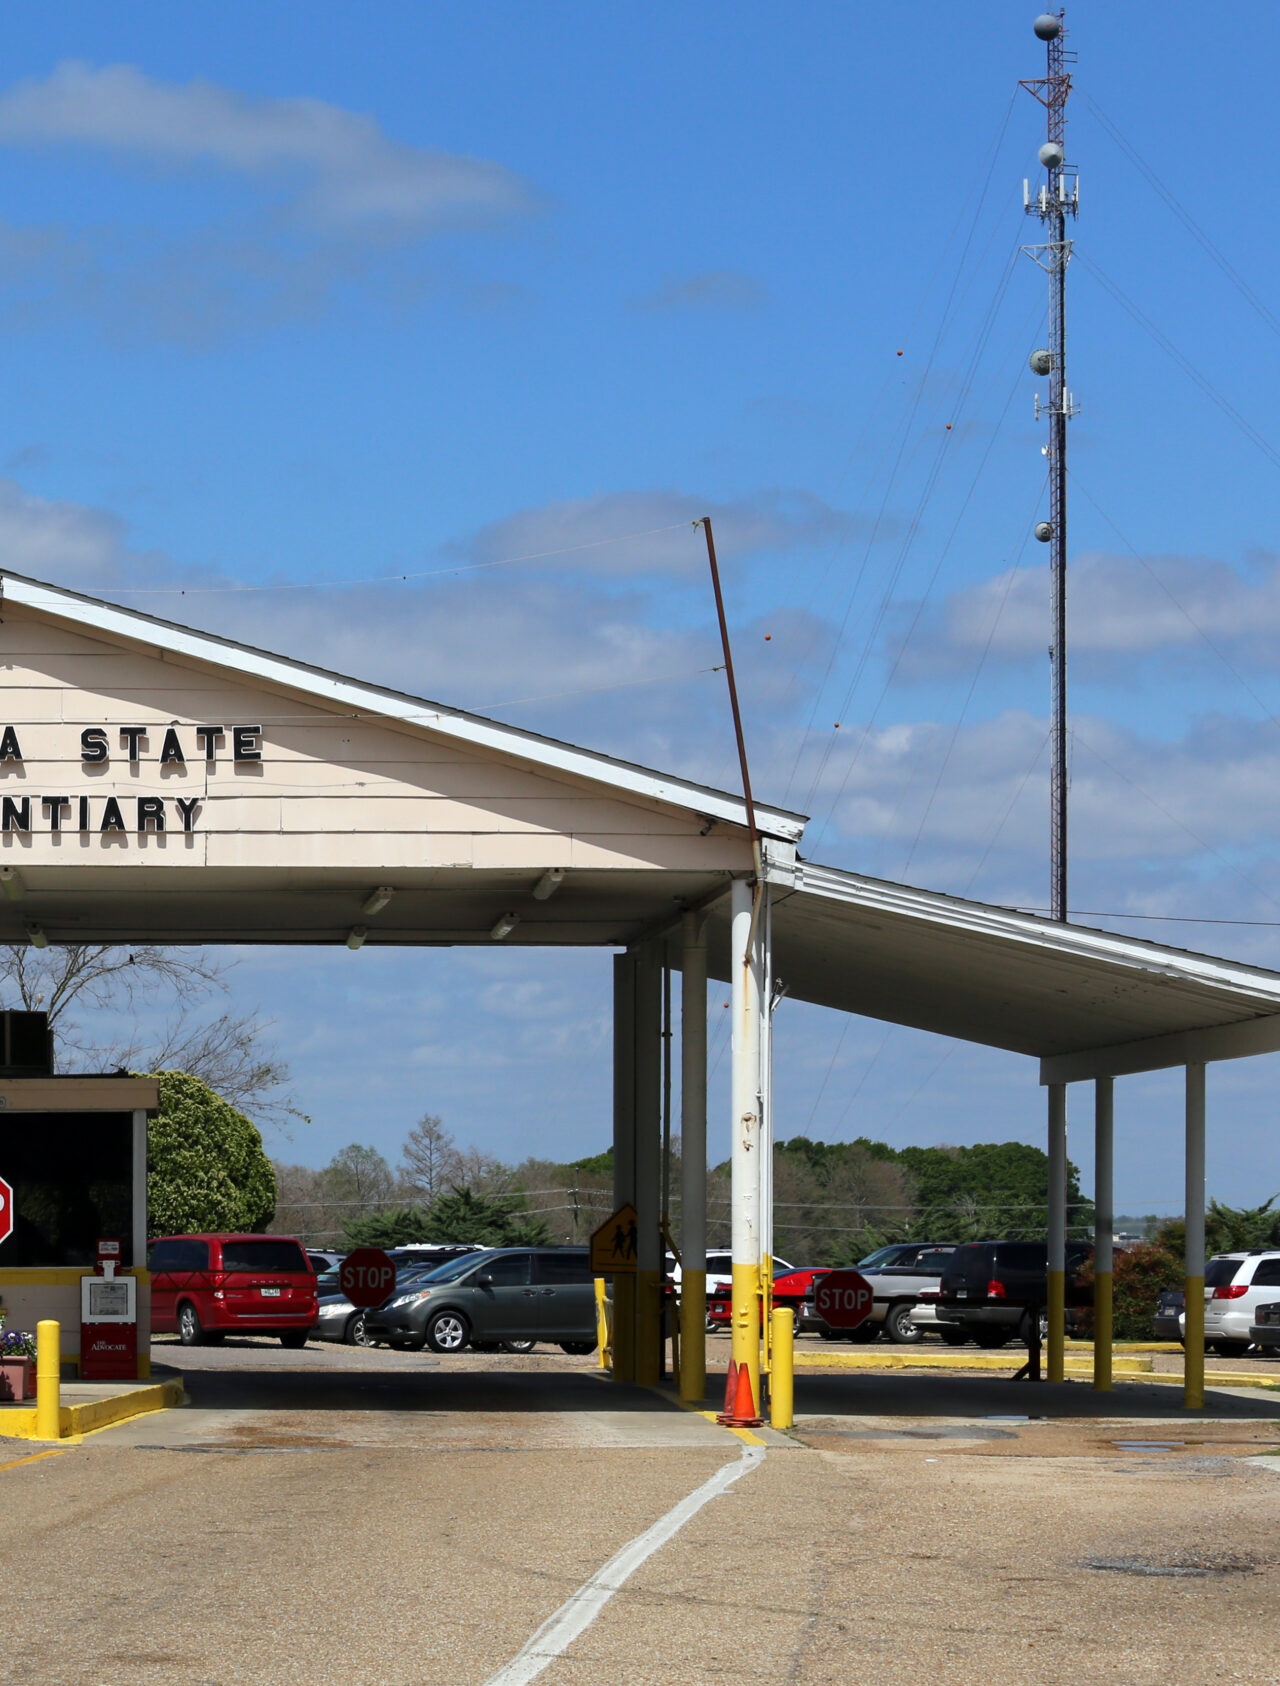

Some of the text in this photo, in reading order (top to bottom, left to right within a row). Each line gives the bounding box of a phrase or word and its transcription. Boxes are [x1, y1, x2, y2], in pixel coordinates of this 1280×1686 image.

[80, 725, 263, 763] STATE
[343, 1266, 393, 1289] STOP
[819, 1288, 870, 1310] STOP
[91, 1343, 127, 1351] ADVOCATE
